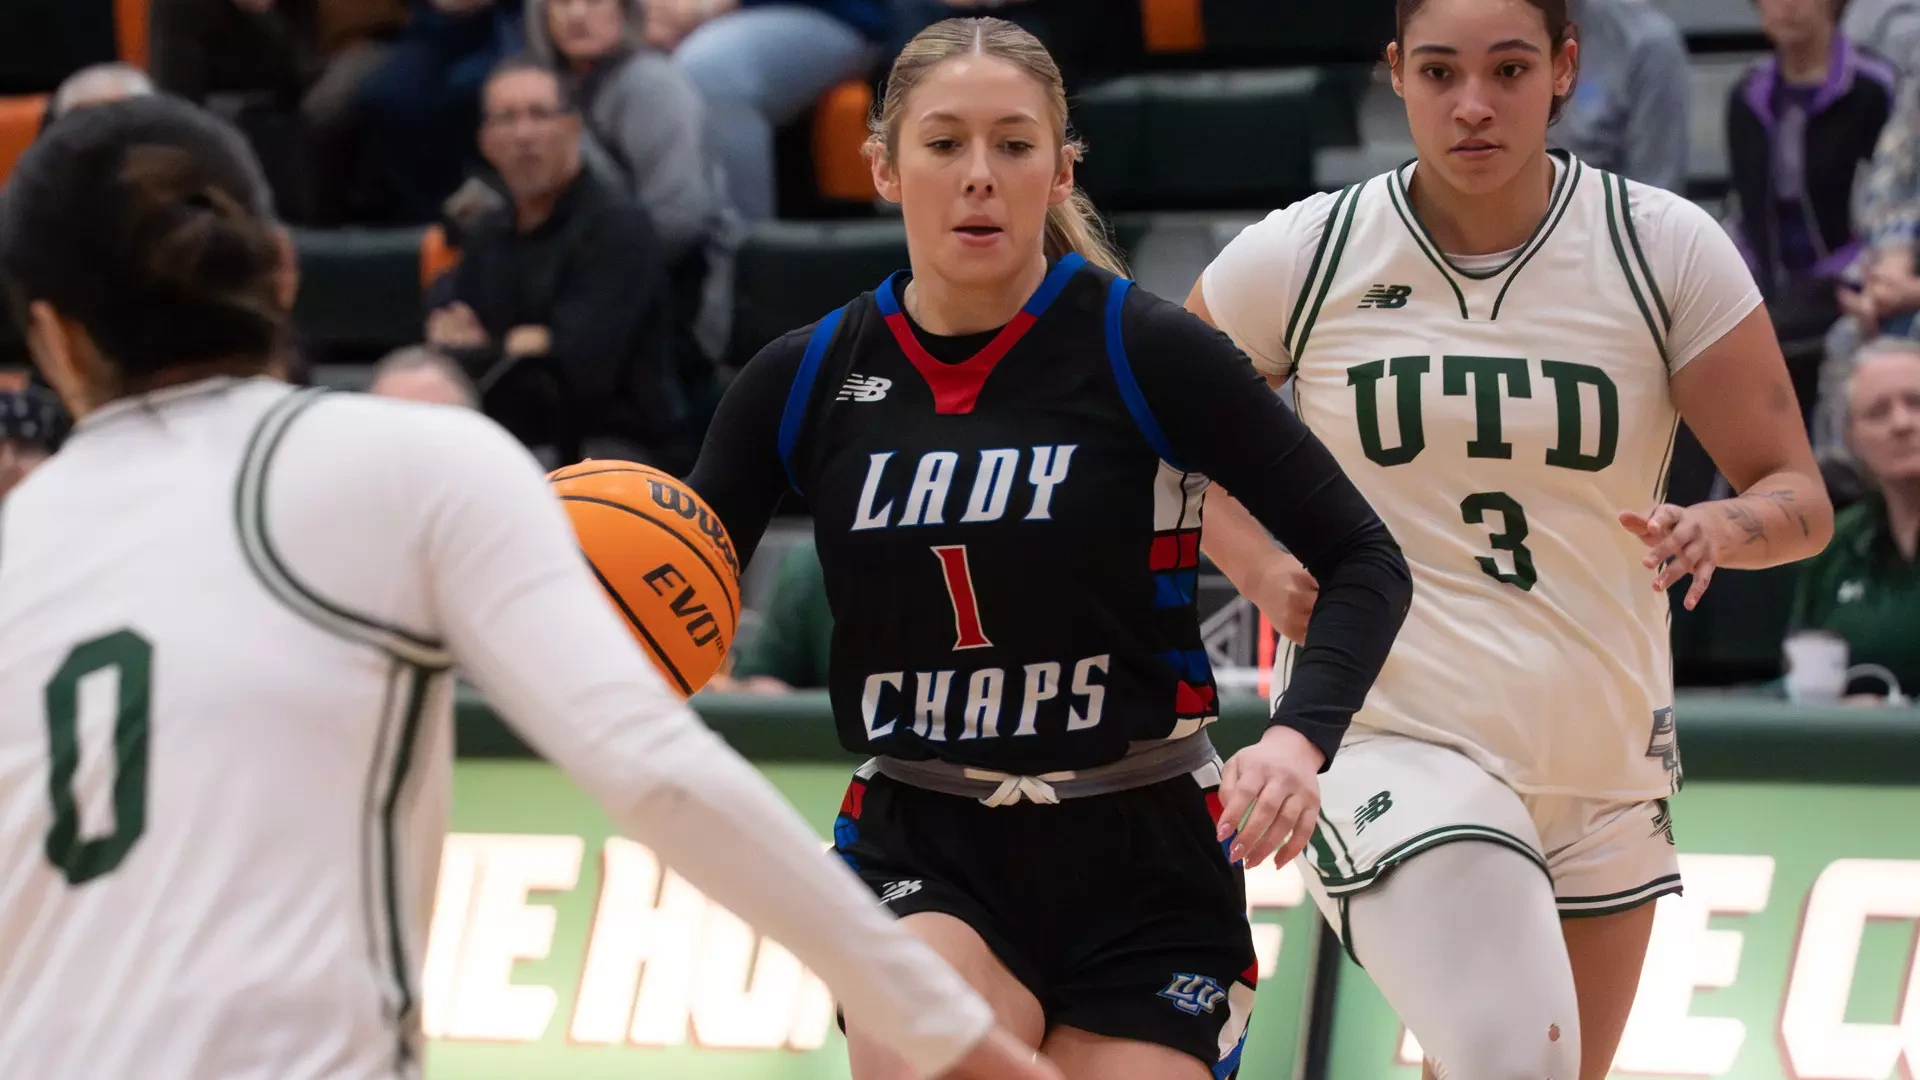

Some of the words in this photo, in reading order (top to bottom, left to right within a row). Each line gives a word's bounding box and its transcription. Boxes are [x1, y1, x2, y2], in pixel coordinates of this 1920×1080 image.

[1347, 355, 1620, 472] UTD
[849, 444, 1079, 532] LADY
[1460, 491, 1538, 592] 3
[929, 544, 994, 652] 1
[861, 654, 1111, 742] CHAPS
[44, 627, 154, 887] 0
